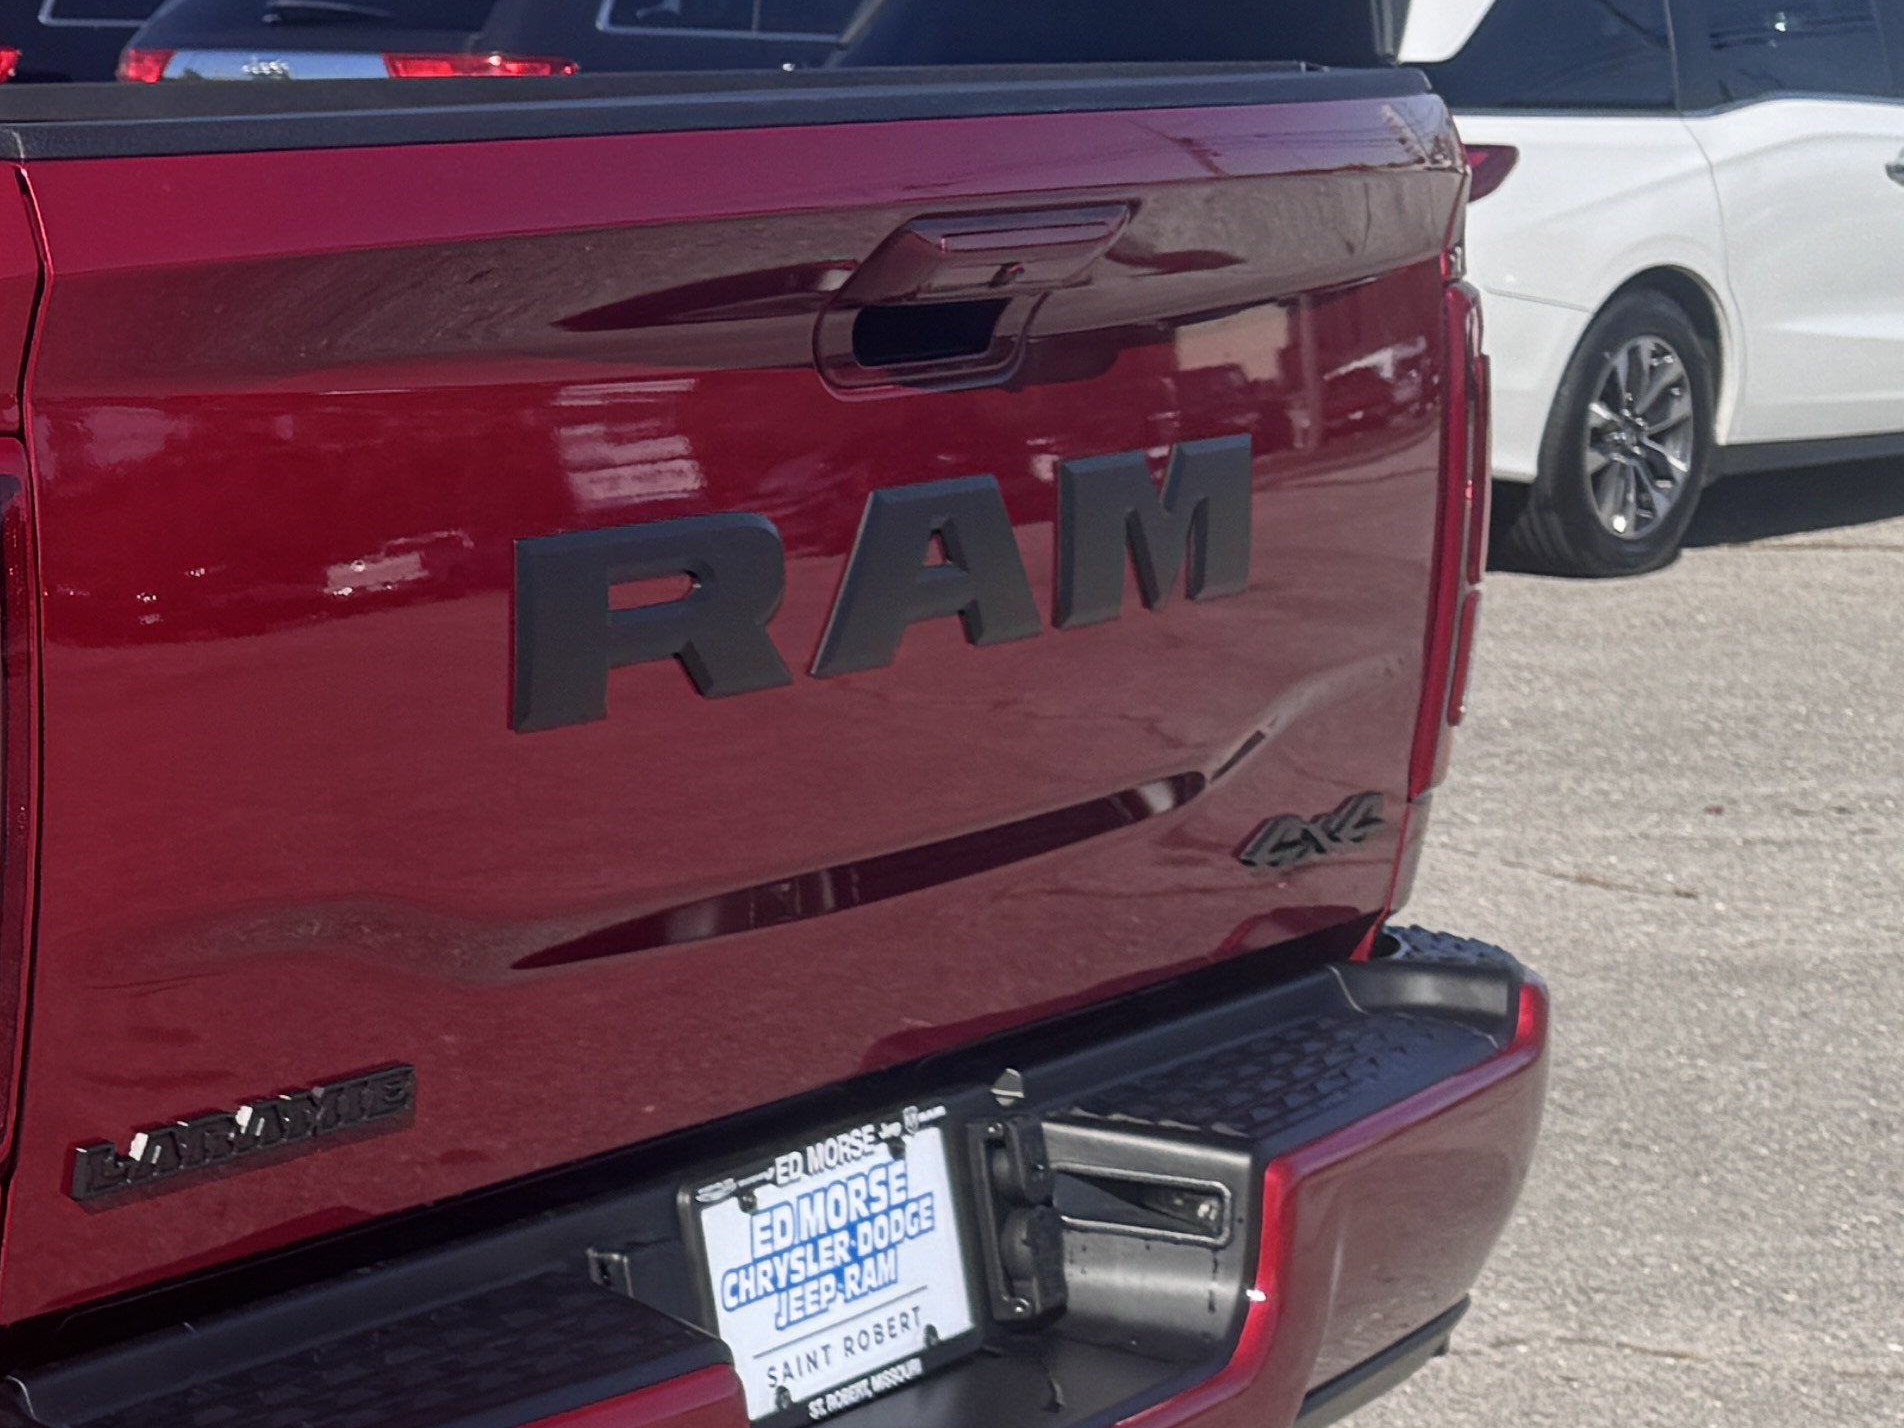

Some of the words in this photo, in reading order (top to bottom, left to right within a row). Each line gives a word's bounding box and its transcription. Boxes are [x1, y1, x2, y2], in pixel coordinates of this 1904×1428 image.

[509, 433, 1254, 734] RAM
[69, 1063, 416, 1201] LARAMIE
[775, 1151, 803, 1184] ED
[807, 1124, 876, 1174] MORSE
[750, 1199, 794, 1260] ED
[796, 1160, 908, 1242] MORSE
[767, 1344, 831, 1388] SAINT
[843, 1305, 921, 1358] ROBERT
